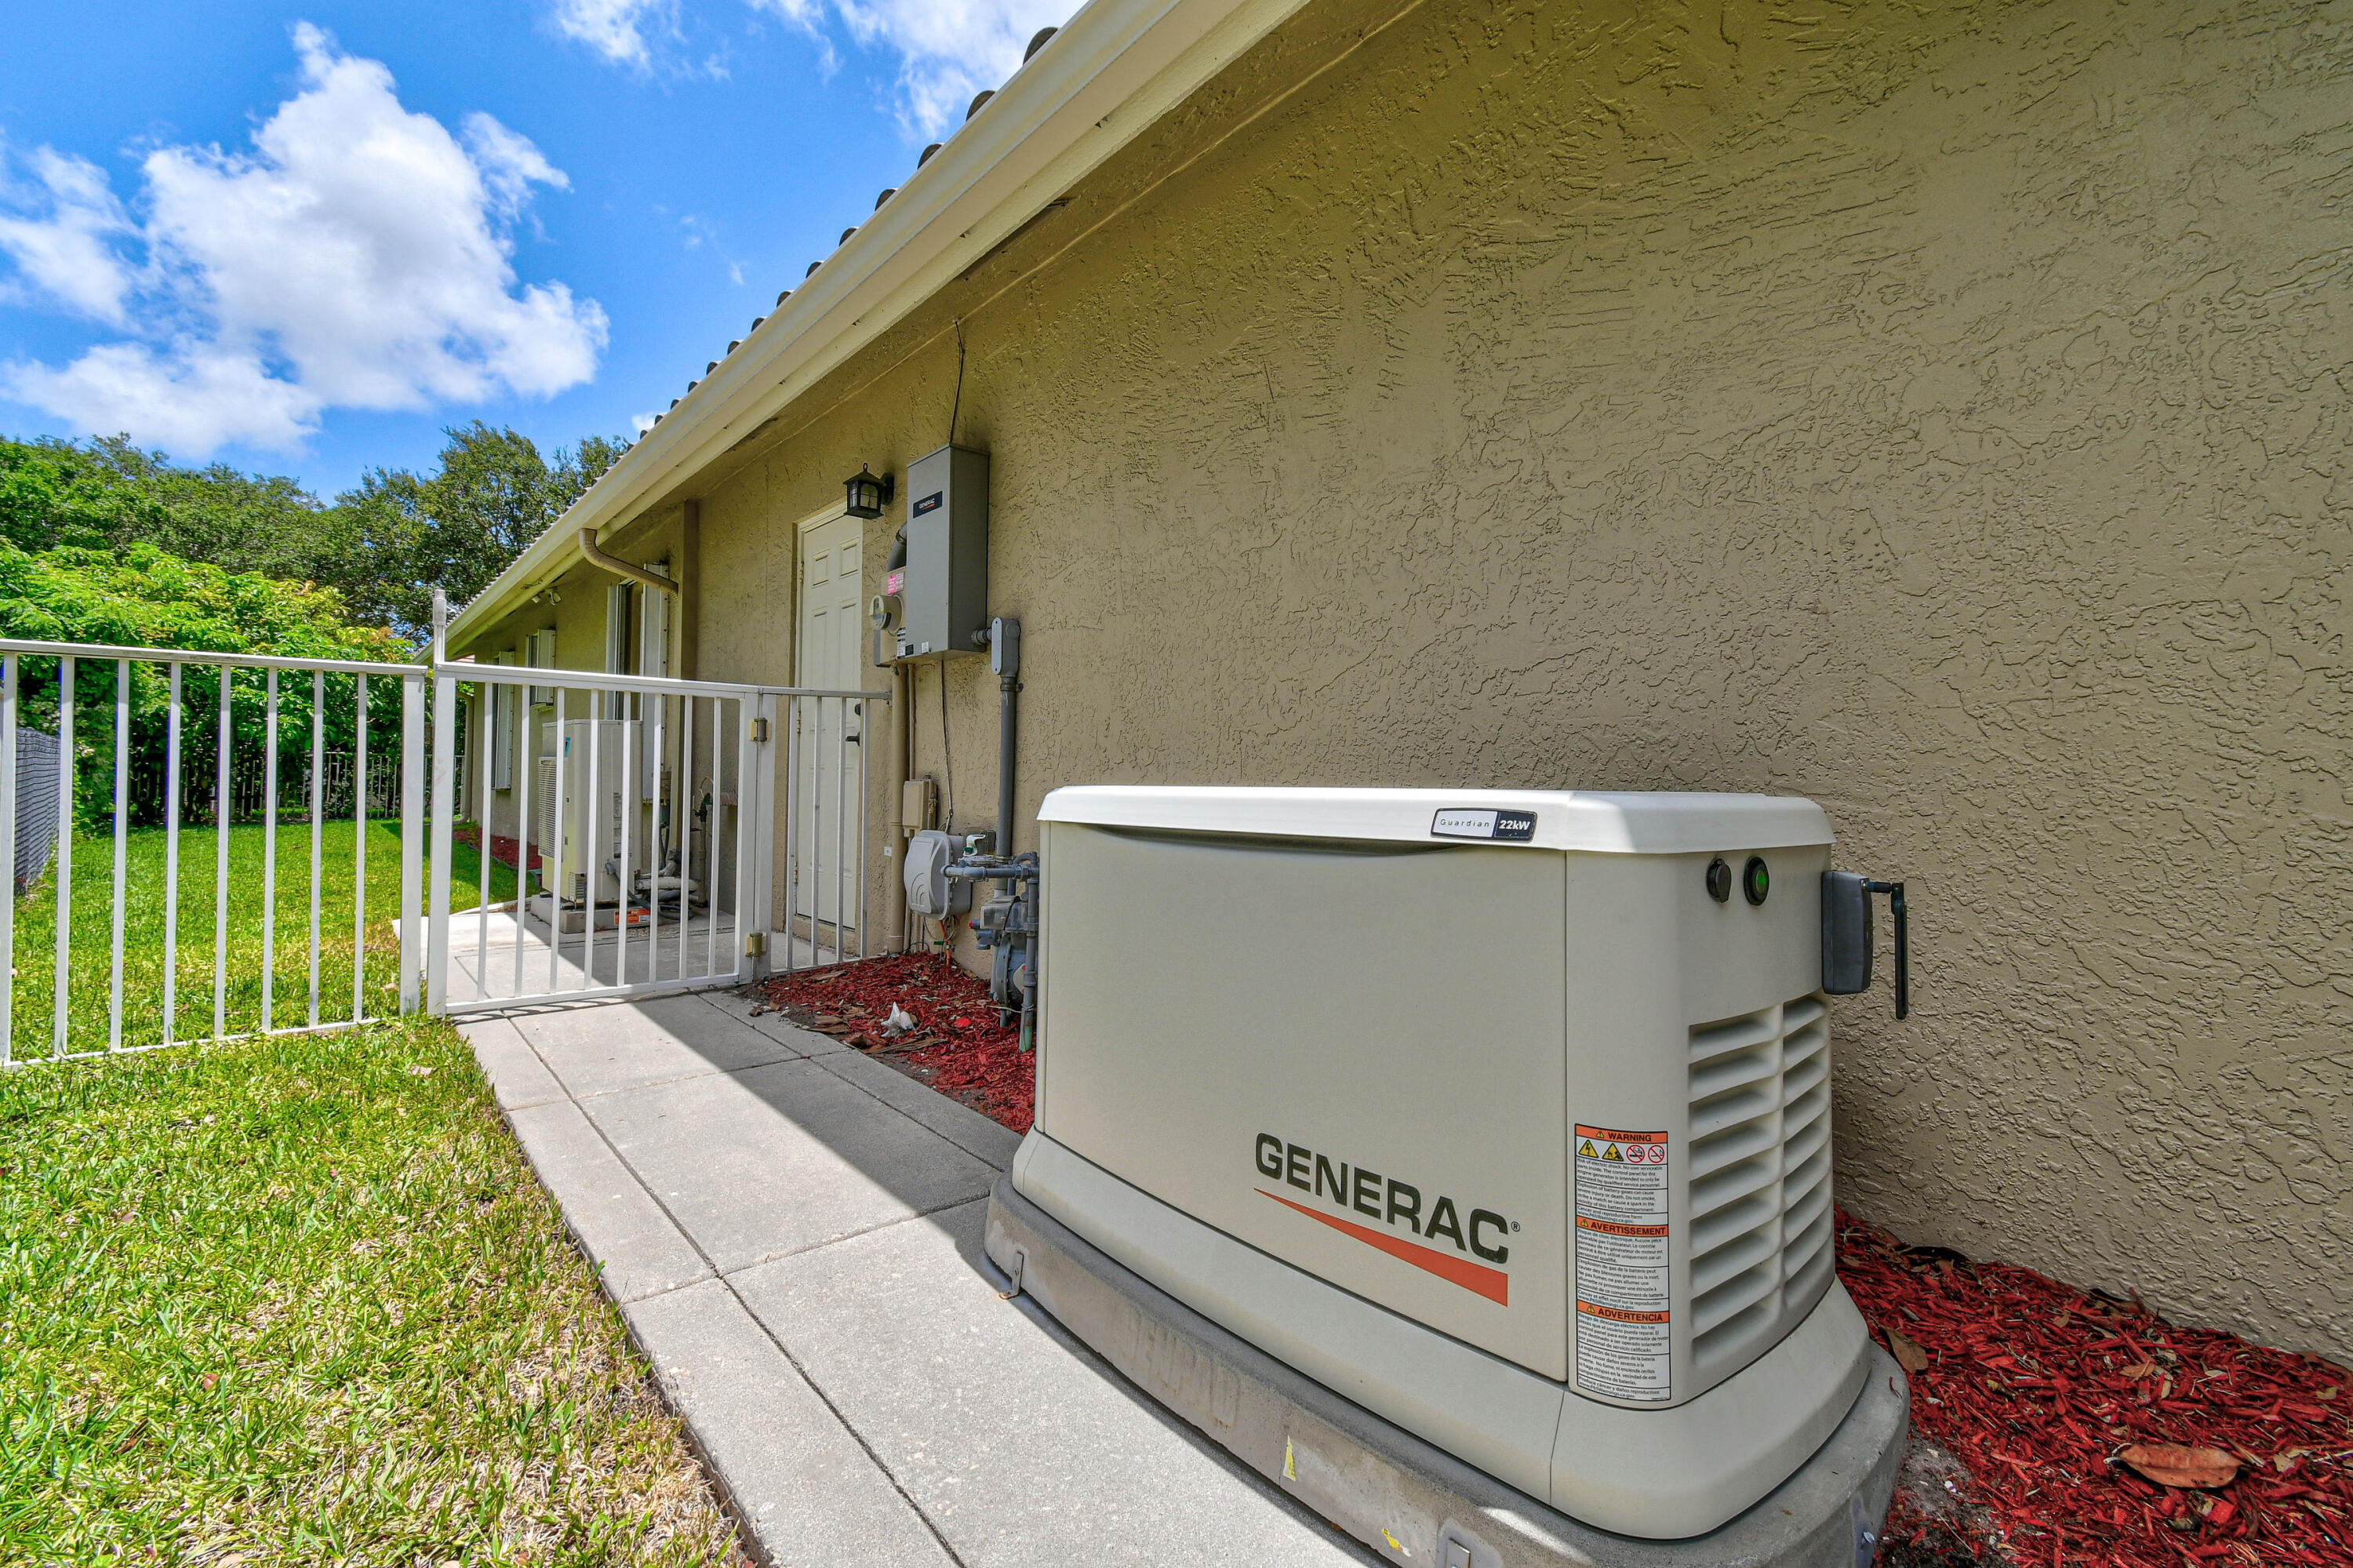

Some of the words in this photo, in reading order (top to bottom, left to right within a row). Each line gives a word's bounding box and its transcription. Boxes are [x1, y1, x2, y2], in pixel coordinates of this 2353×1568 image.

[1440, 818, 1489, 828] Guardian
[1499, 820, 1531, 831] 22kW
[1608, 1132, 1652, 1142] WARNING
[1255, 1132, 1509, 1264] GENERAC
[1591, 1221, 1665, 1235] AVERTISSEMENT
[1598, 1308, 1663, 1321] ADVERTENCIA
